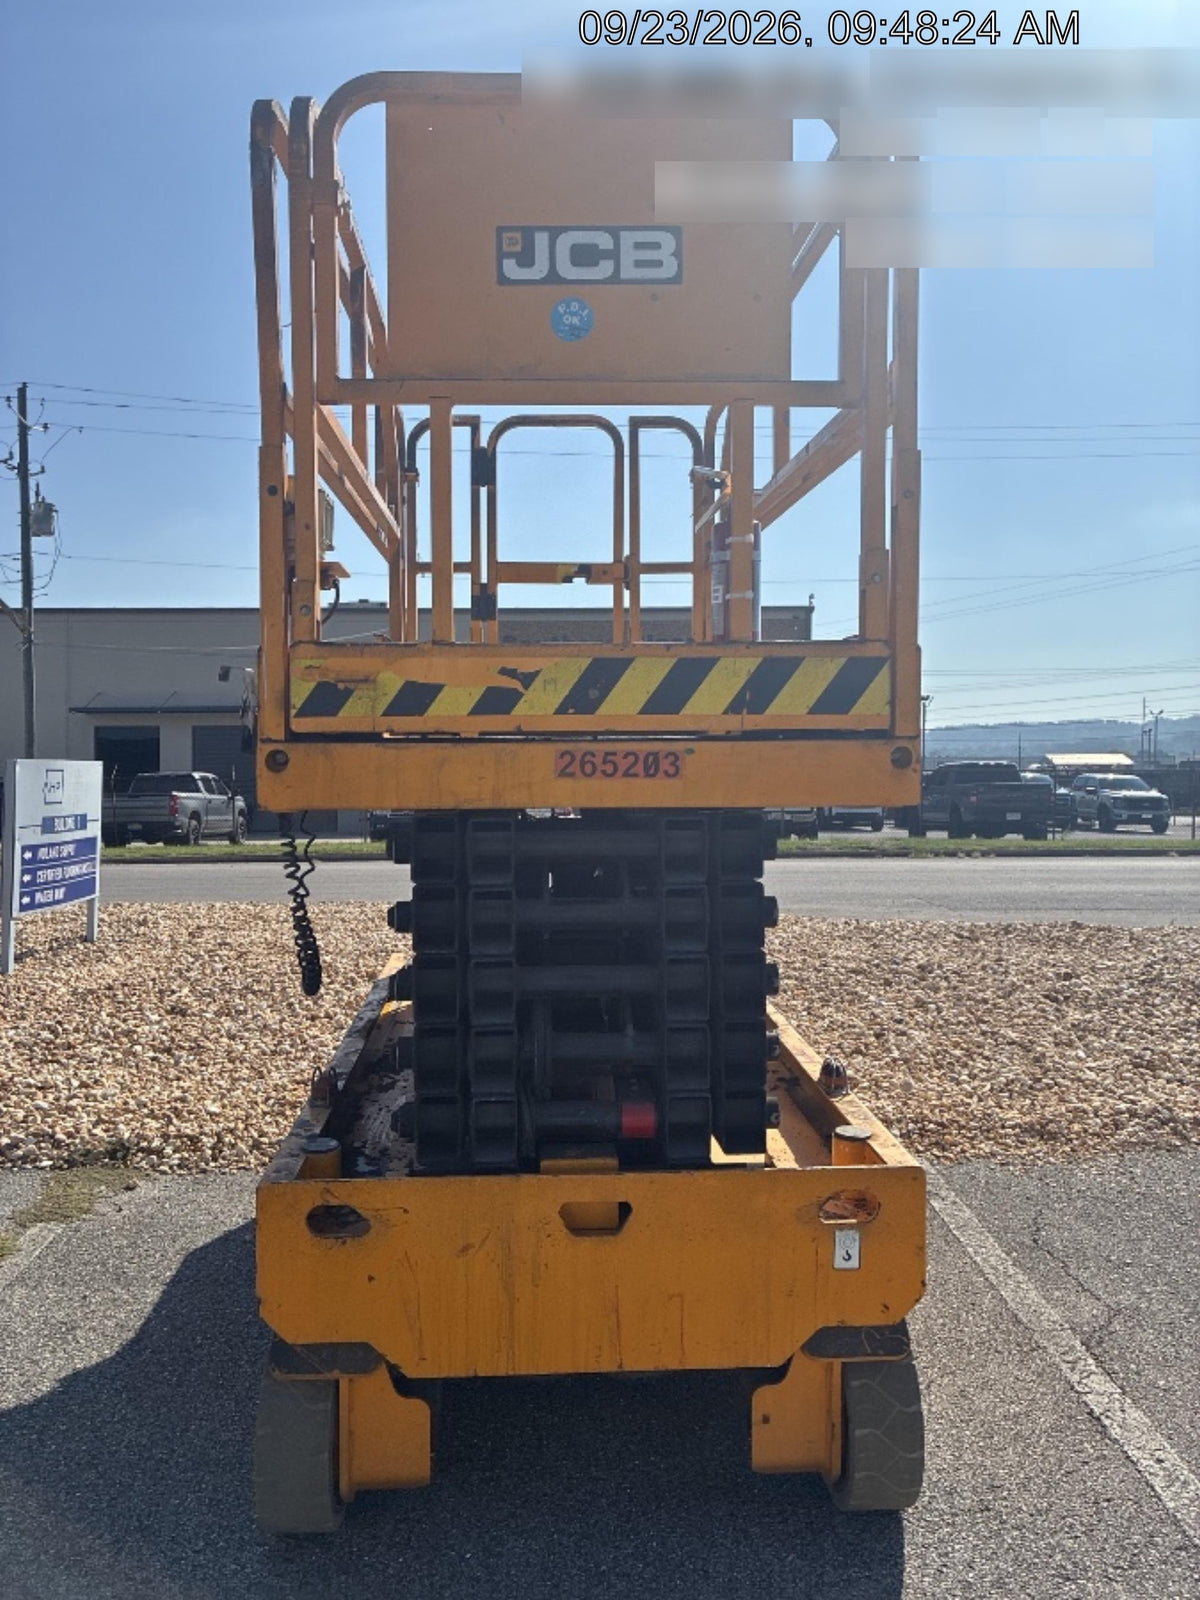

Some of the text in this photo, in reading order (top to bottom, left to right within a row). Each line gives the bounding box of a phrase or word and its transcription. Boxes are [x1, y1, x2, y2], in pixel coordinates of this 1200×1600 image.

[502, 230, 679, 280] JCB
[563, 314, 580, 326] OK
[557, 750, 681, 778] 265203
